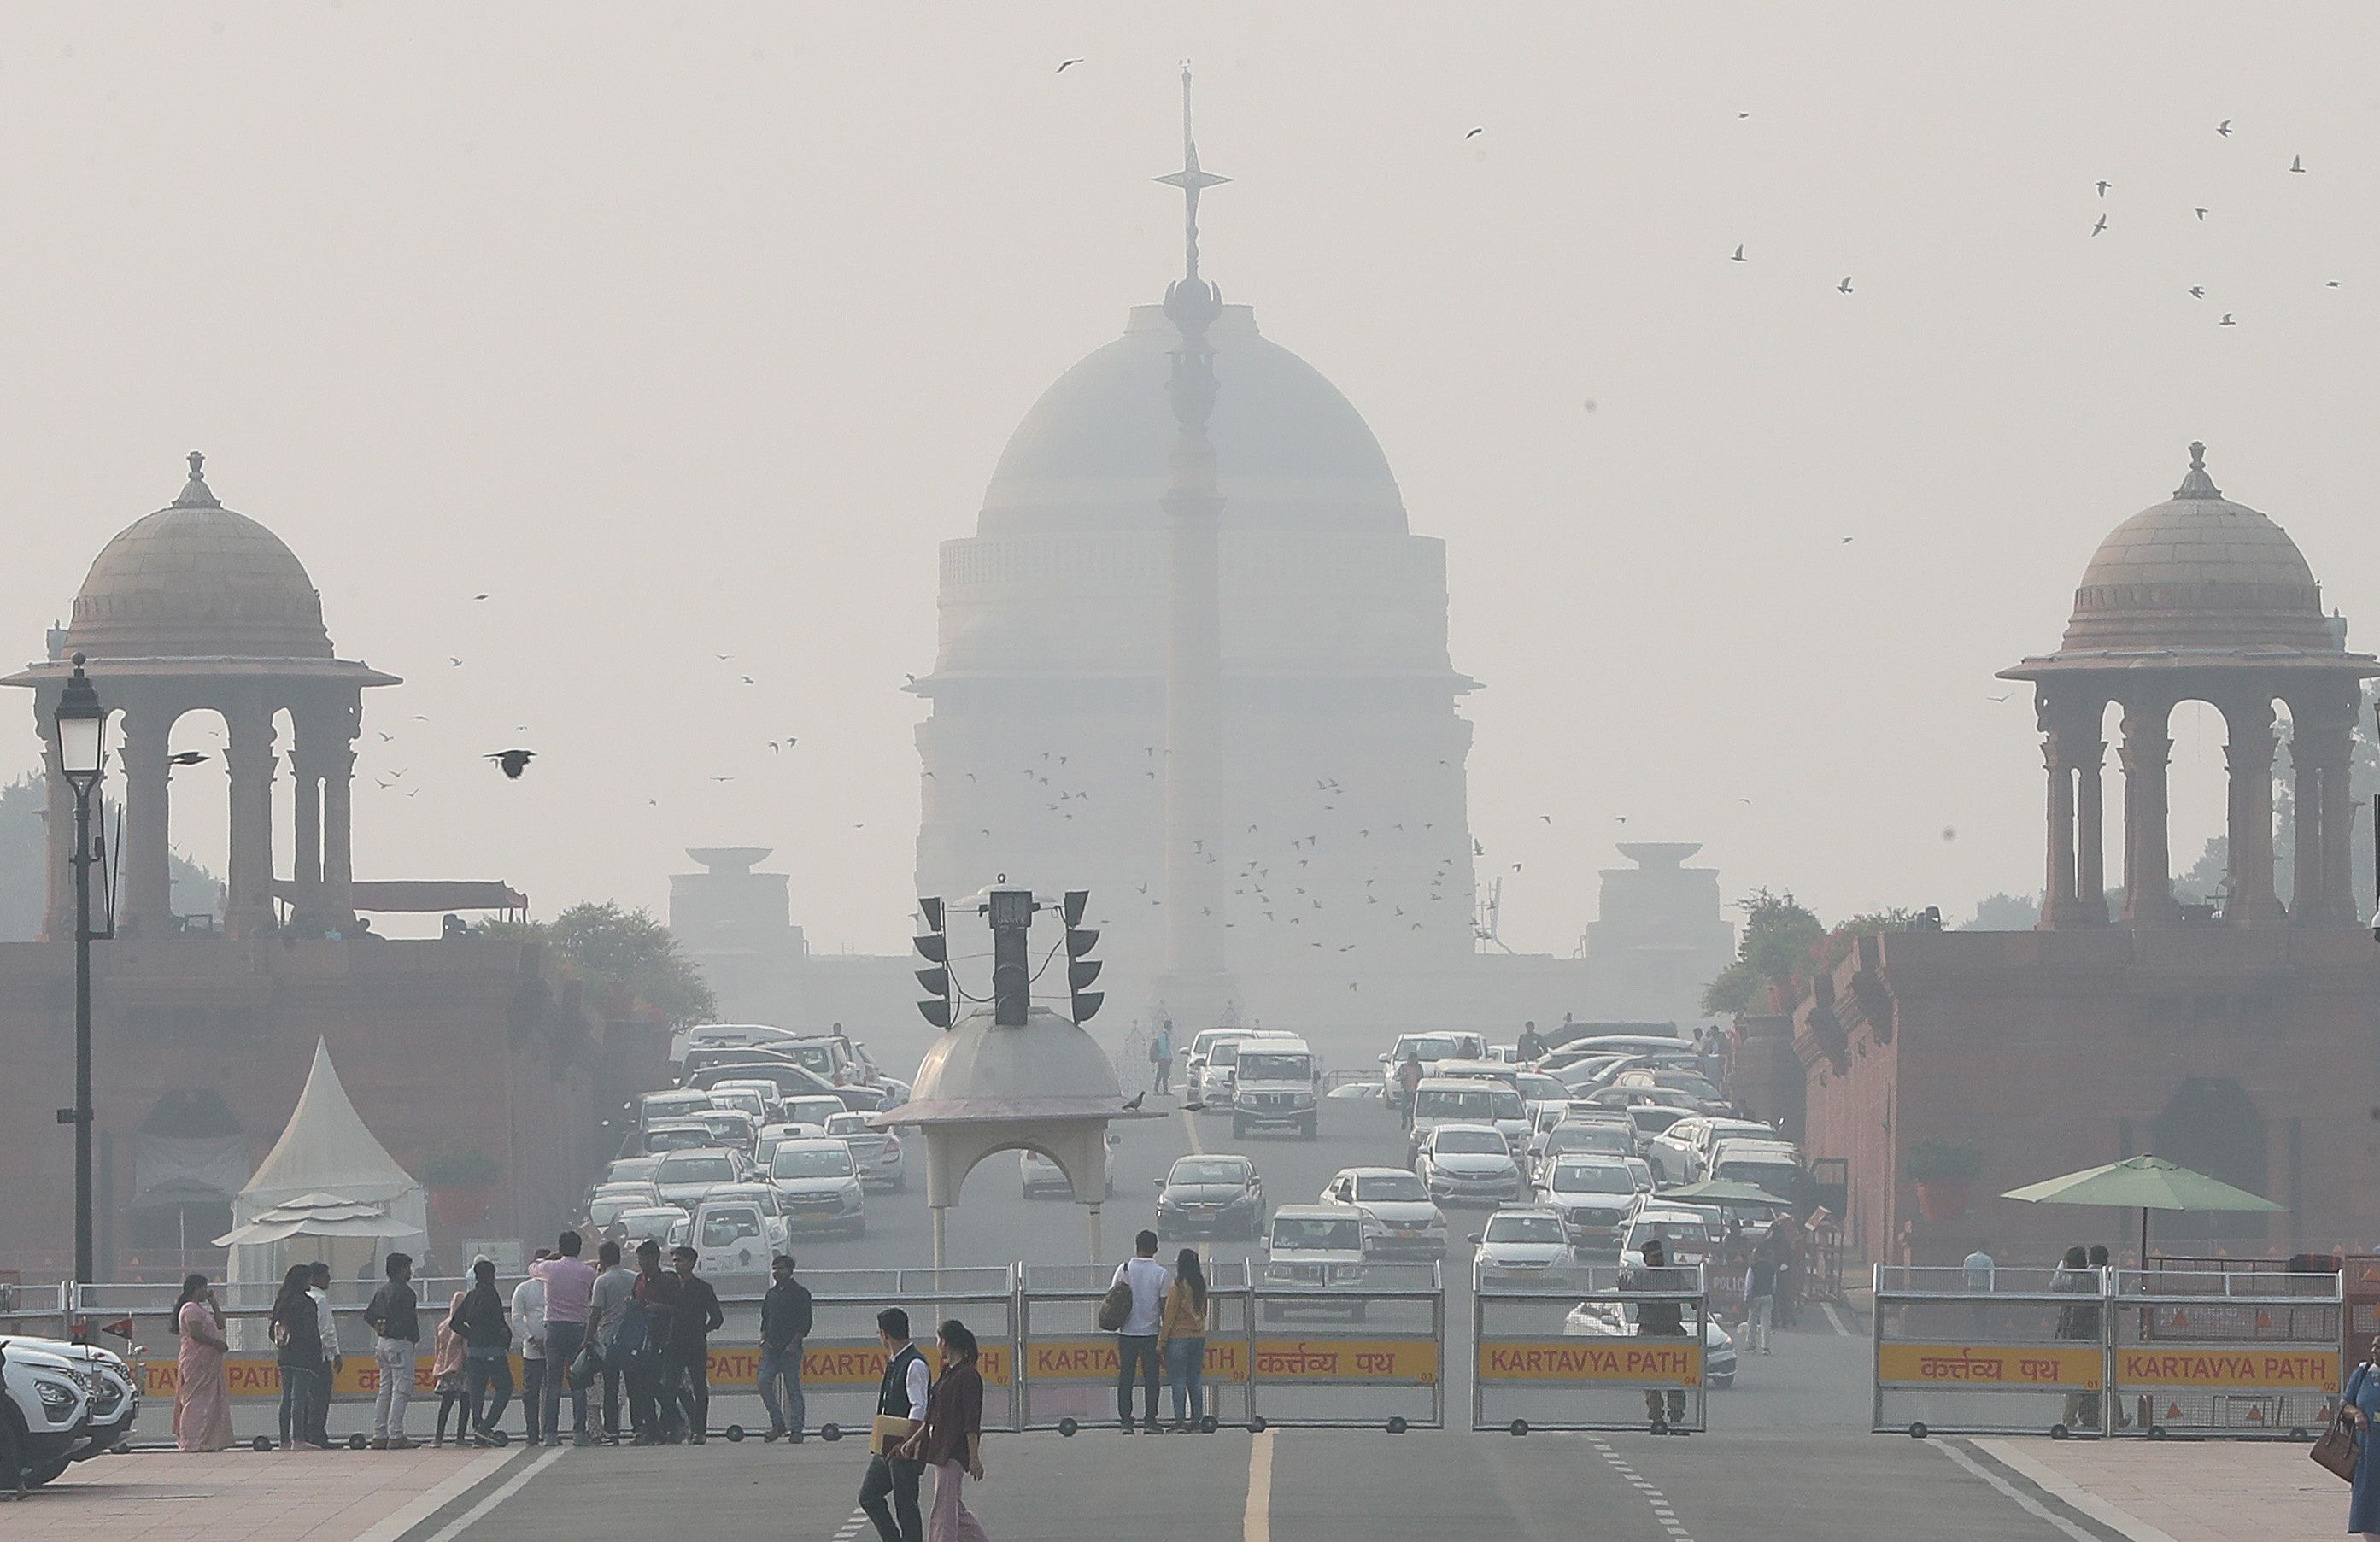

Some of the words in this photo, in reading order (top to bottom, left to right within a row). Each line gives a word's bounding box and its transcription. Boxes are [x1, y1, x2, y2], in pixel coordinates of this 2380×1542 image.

[1713, 1276, 1745, 1292] POLIC
[1355, 1352, 1395, 1374] पथ
[1491, 1349, 1620, 1373] KARTAVYA
[1627, 1351, 1688, 1374] PATH
[2019, 1359, 2060, 1381] पथ
[2126, 1356, 2256, 1380] KARTAVYA
[2264, 1357, 2326, 1381] PATH
[2087, 1380, 2099, 1389] 01
[2323, 1382, 2336, 1392] 02
